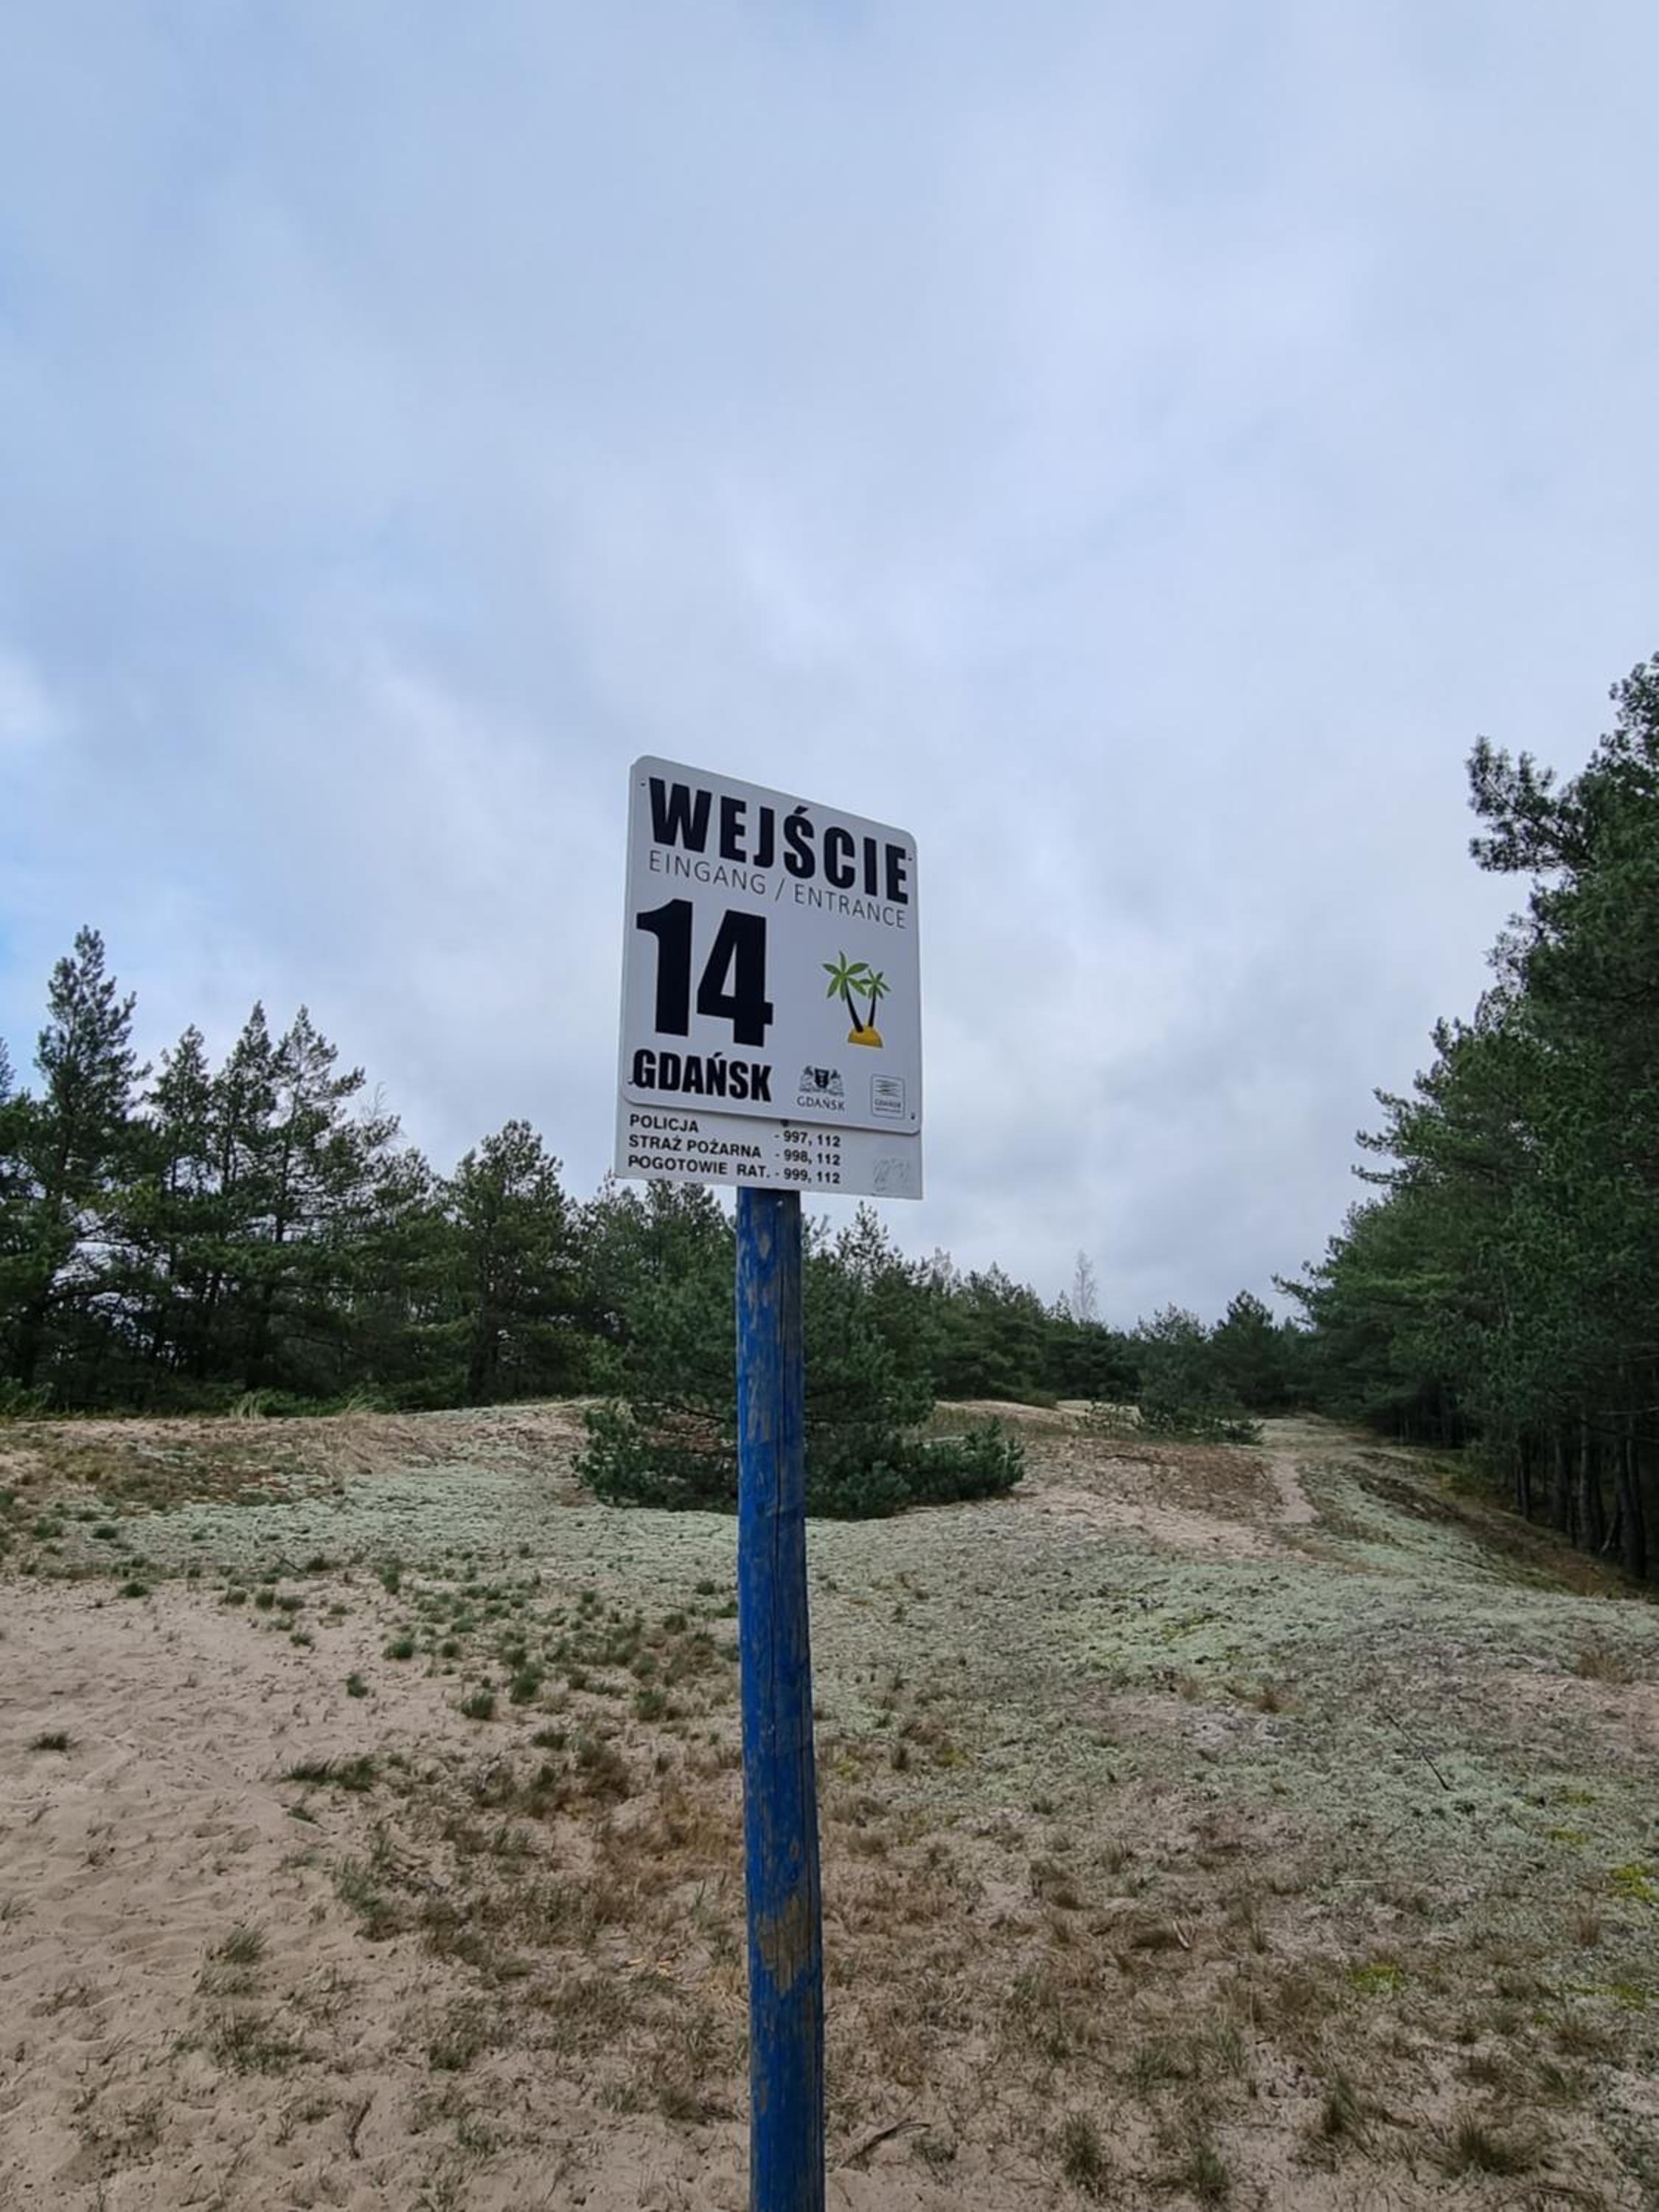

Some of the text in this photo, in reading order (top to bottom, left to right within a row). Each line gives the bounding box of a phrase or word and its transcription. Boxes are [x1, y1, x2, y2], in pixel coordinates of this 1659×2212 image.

[649, 776, 908, 905] WEJŚCIE
[650, 849, 907, 929] EINGANG / ENTRANCE
[636, 898, 773, 1048] 14
[633, 1048, 772, 1102] GDAŃSK
[628, 1134, 683, 1152] STRAŻ
[686, 1138, 762, 1158] POŻARNA
[784, 1149, 813, 1165] 998,
[818, 1152, 841, 1166] 112
[630, 1113, 699, 1133] POLICJA
[784, 1130, 813, 1147] 997,
[818, 1134, 841, 1147] 112
[628, 1155, 728, 1175] POGOTOWIE
[737, 1163, 771, 1178] RAT.
[784, 1168, 812, 1183] 999,
[817, 1171, 841, 1184] 112
